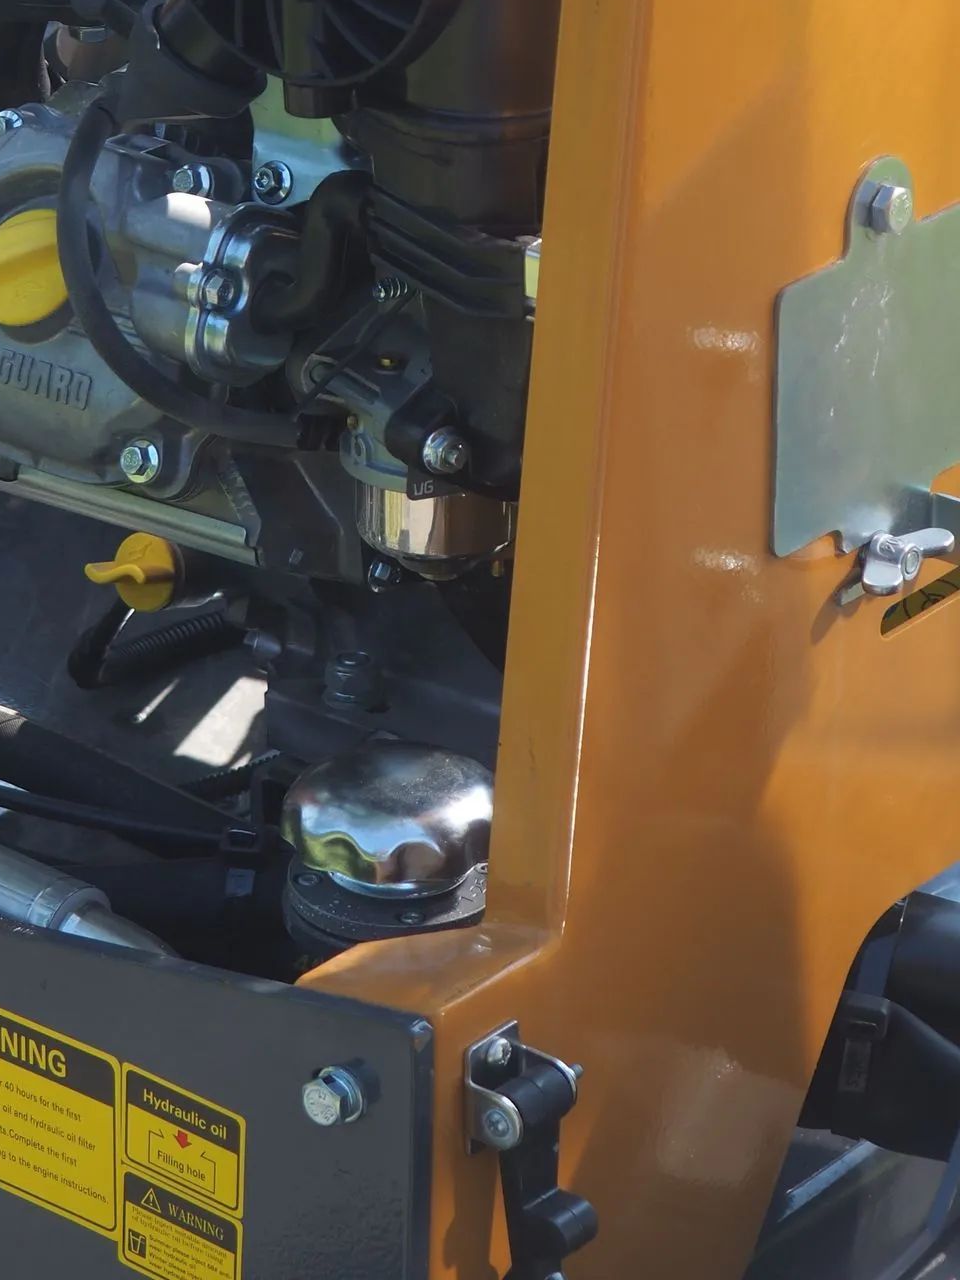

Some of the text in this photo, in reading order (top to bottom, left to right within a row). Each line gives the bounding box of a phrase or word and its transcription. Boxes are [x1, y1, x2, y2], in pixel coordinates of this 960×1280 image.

[4, 1080, 14, 1092] 40
[16, 1086, 37, 1102] hours
[39, 1096, 49, 1107] for
[52, 1101, 64, 1114] the
[66, 1107, 80, 1121] first
[143, 1088, 226, 1140] Hydraulic oil
[2, 1104, 11, 1114] oil
[14, 1110, 27, 1121] and
[31, 1115, 64, 1137] hydraulic
[67, 1132, 76, 1142] oil
[78, 1136, 95, 1151] filter
[8, 1151, 16, 1162] to
[19, 1156, 30, 1168] the
[33, 1164, 58, 1180] engine
[46, 1145, 59, 1158] the
[61, 1152, 77, 1166] first
[157, 1149, 205, 1181] Filling hole
[168, 1201, 224, 1241] WARNING
